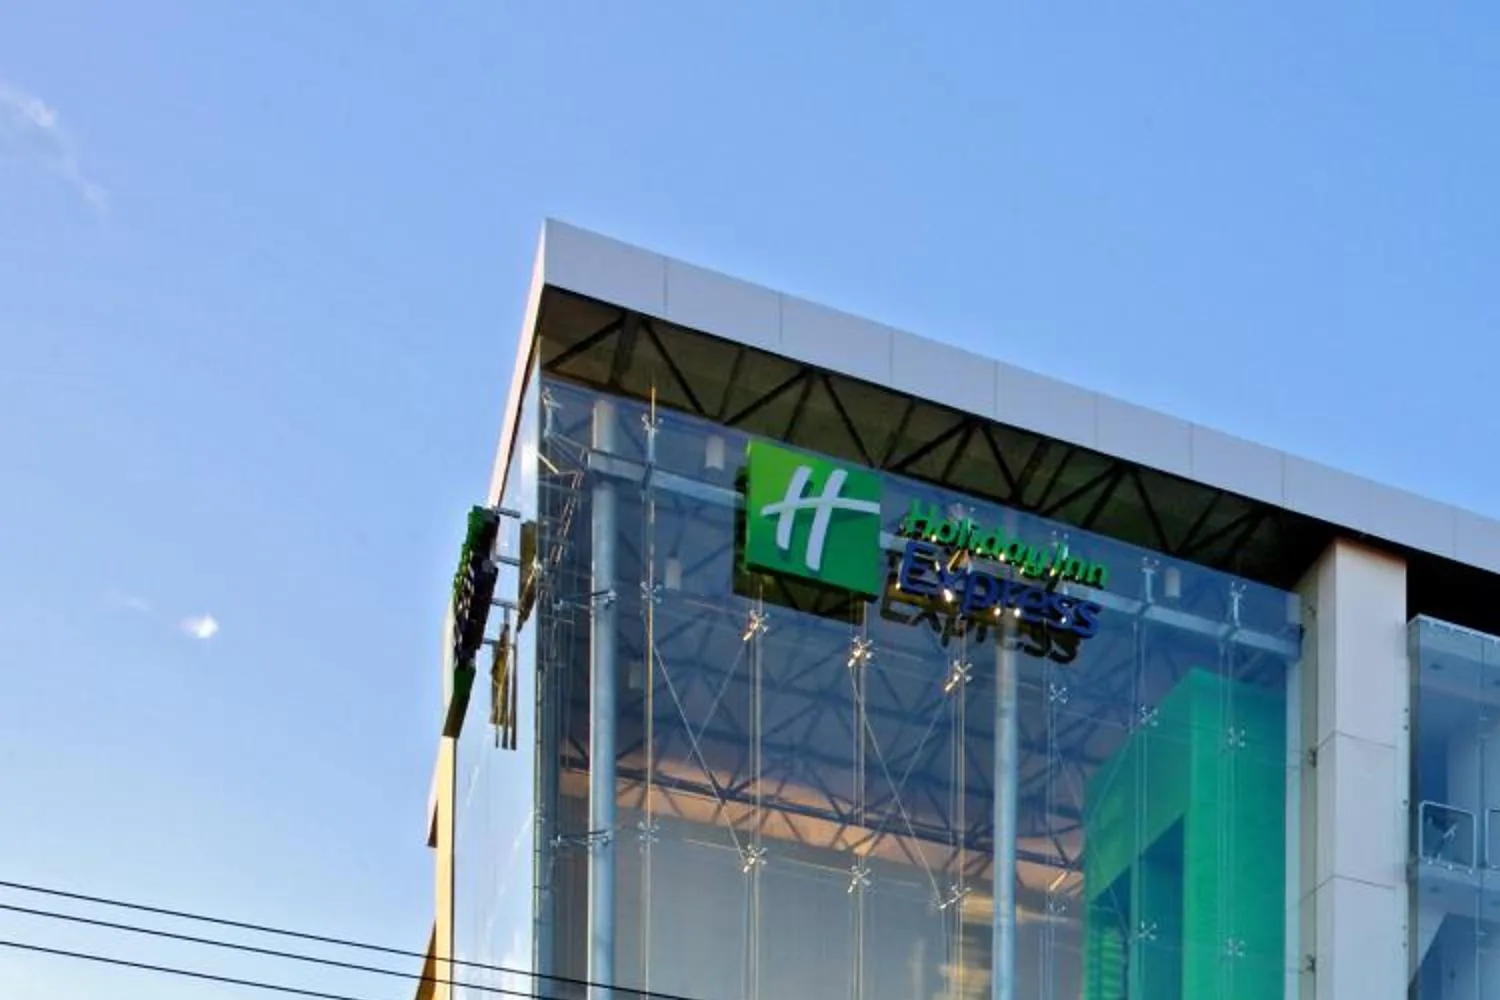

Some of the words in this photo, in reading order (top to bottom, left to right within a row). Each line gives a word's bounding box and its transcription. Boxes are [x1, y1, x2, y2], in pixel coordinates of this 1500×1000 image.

[898, 540, 1102, 639] Express
[904, 498, 1047, 578] Holiday
[1050, 541, 1109, 590] Inn
